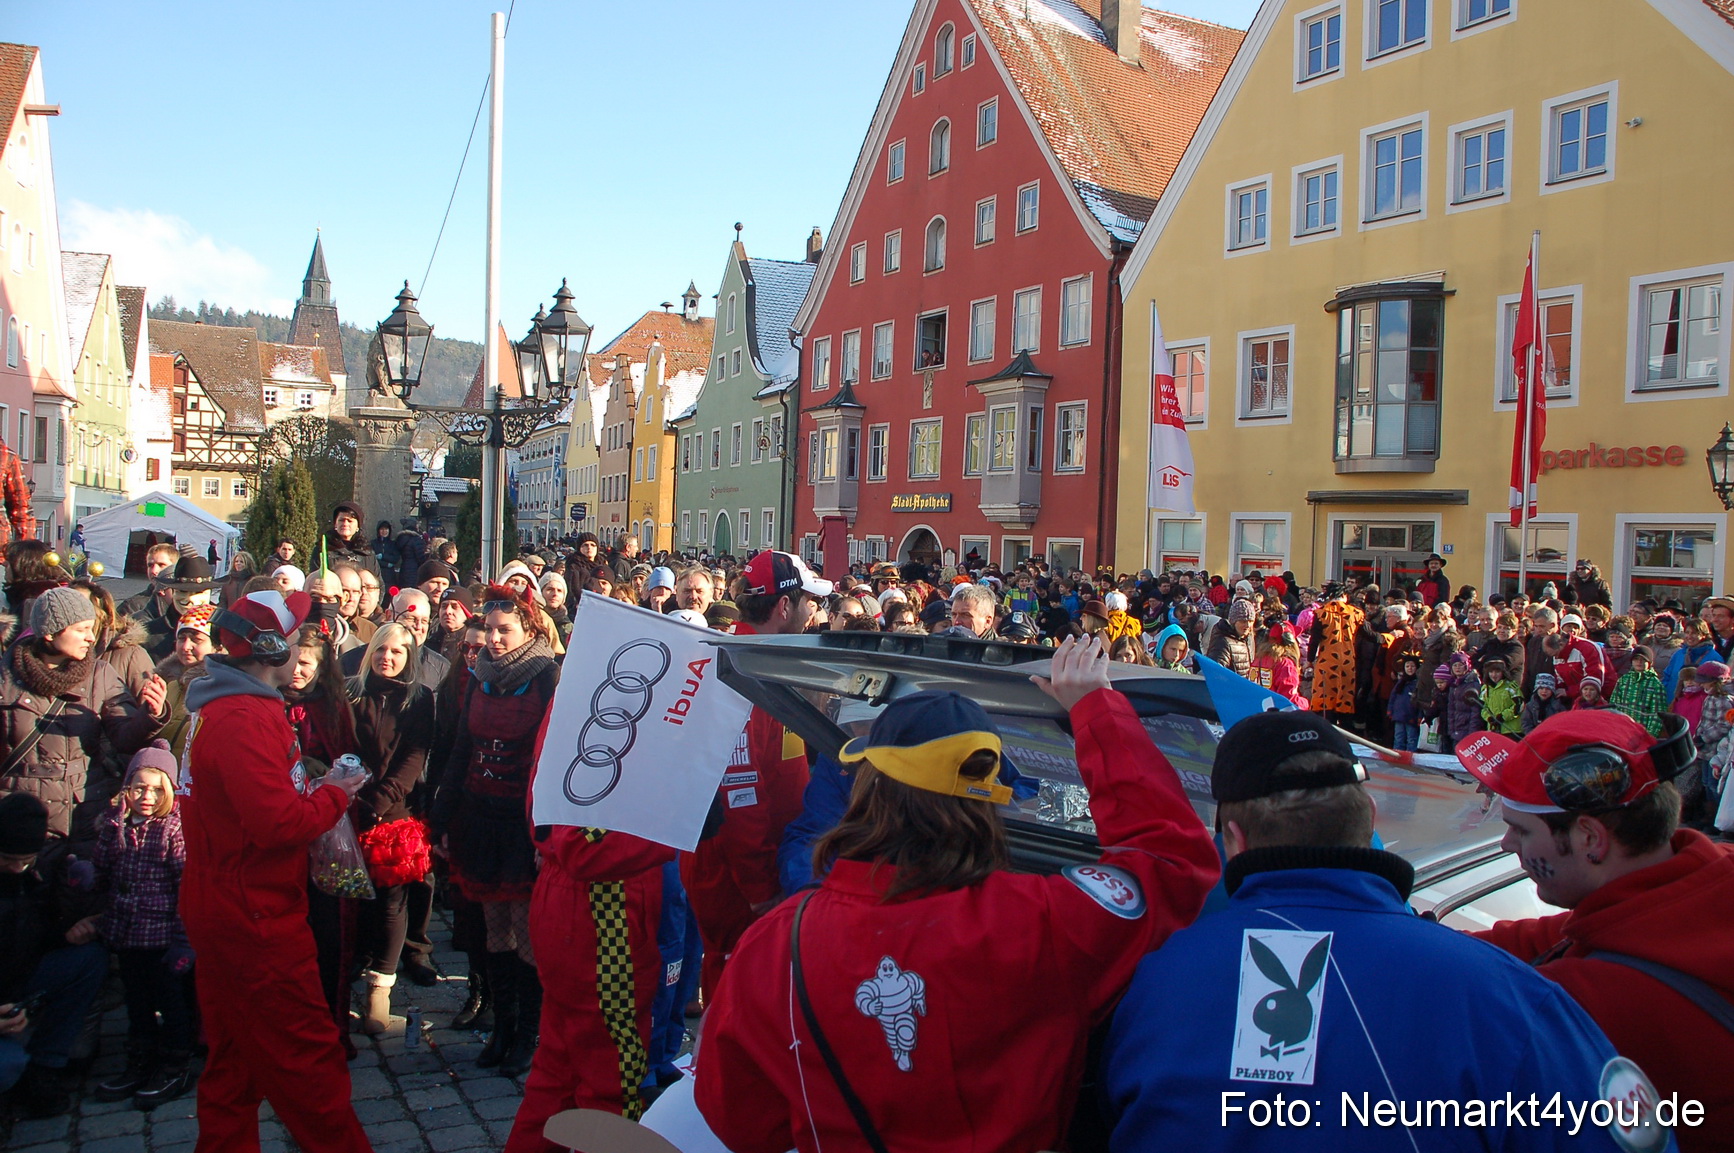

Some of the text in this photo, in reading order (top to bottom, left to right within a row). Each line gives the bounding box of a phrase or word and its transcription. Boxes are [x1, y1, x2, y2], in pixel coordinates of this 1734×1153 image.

[1160, 384, 1174, 393] Wir
[1161, 395, 1176, 406] hrer
[1538, 442, 1686, 475] parkasse
[779, 578, 798, 589] DTM
[1235, 1067, 1295, 1082] PLAYBOY
